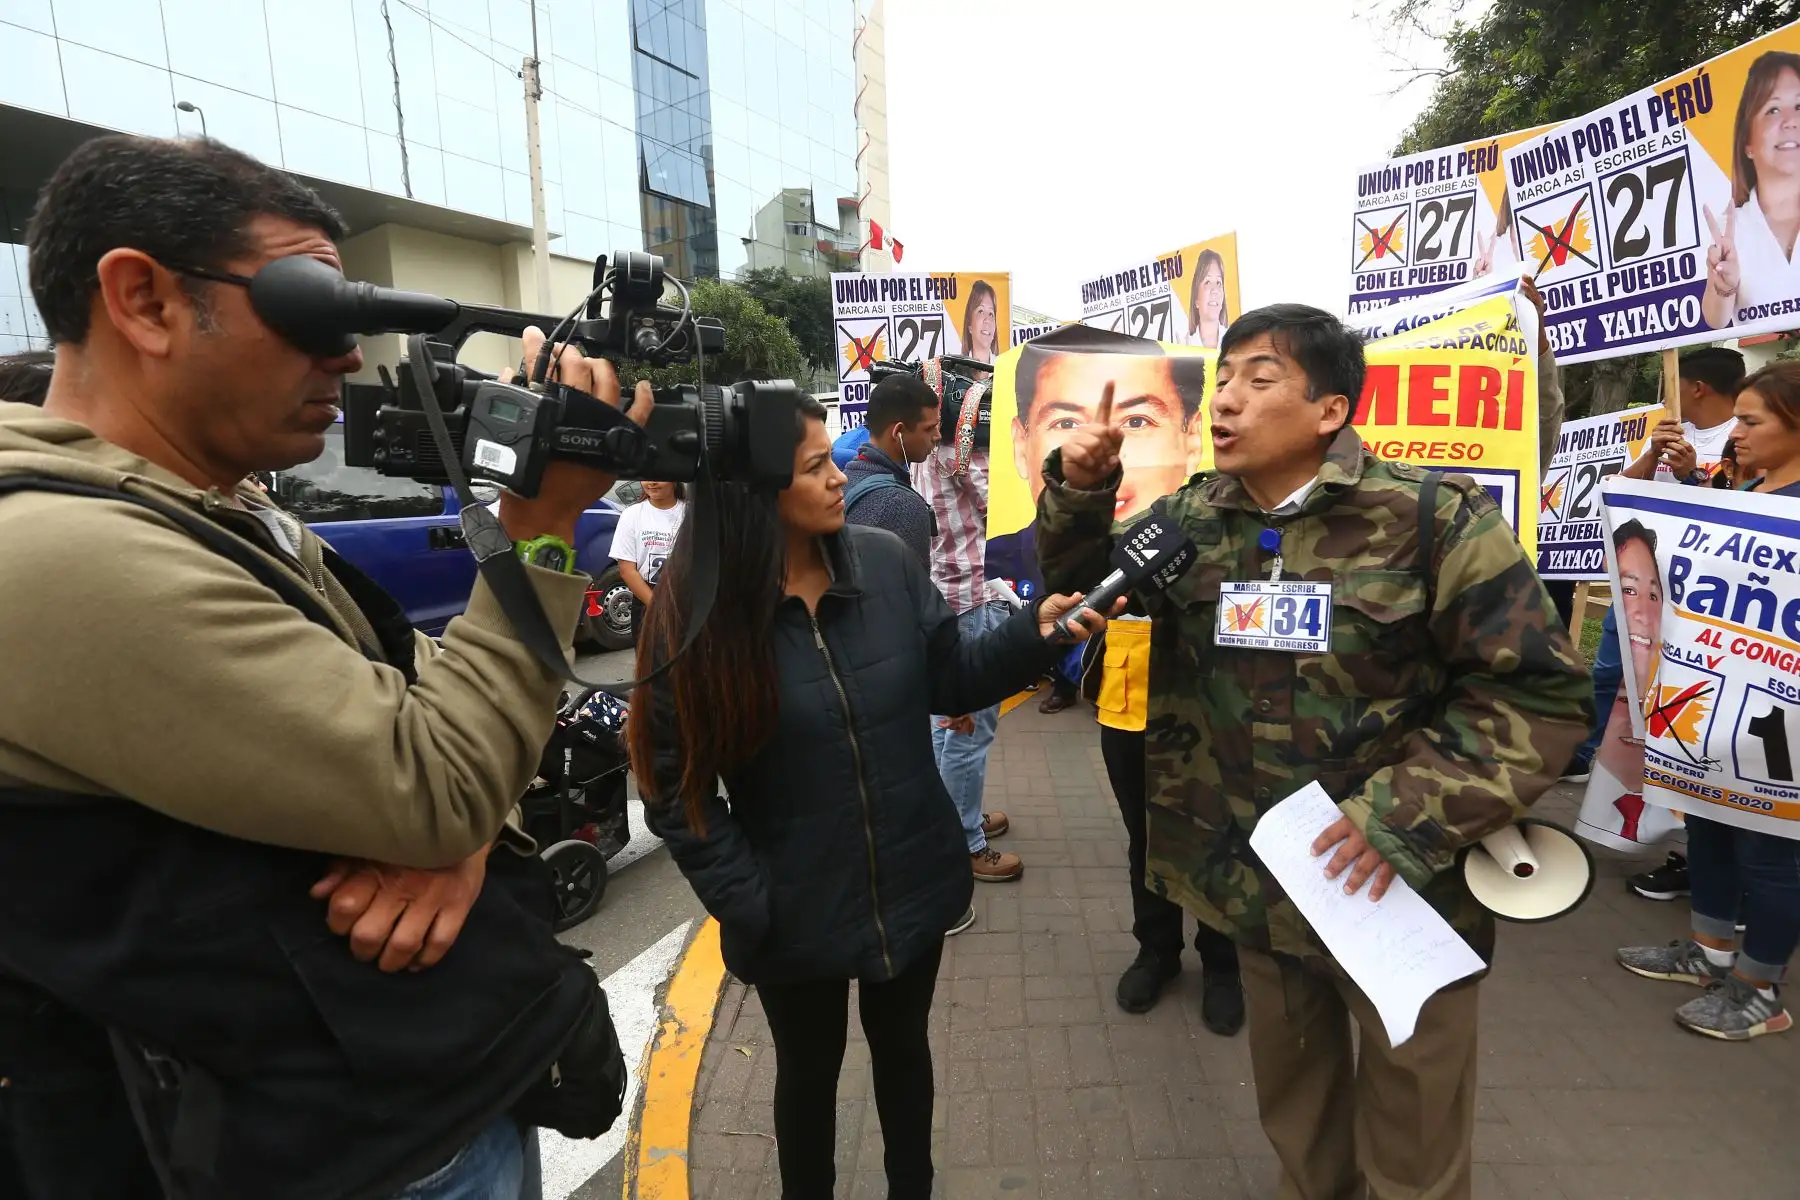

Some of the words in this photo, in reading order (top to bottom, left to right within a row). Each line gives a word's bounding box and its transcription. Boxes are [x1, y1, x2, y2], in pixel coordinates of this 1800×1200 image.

[1510, 136, 1572, 188] UNIÓN
[1572, 117, 1618, 163] POR
[1619, 104, 1647, 145] EL
[1647, 67, 1713, 133] PERÚ
[1595, 140, 1658, 174] ESCRIBE
[1661, 124, 1687, 148] ASÍ
[1358, 164, 1402, 197] UNIÓN
[1405, 159, 1434, 189] POR
[1438, 155, 1453, 182] EL
[1457, 140, 1499, 178] PERÚ
[1415, 181, 1458, 198] ESCRIBE
[1516, 178, 1561, 203] MARCA
[1564, 165, 1585, 186] ASÍ
[1358, 194, 1391, 209] MARCA
[1392, 190, 1409, 202] ASÍ
[1606, 156, 1687, 264] 27
[1415, 196, 1474, 262] 27
[835, 275, 878, 304] UNIÓN
[881, 278, 907, 302] POR
[910, 278, 923, 301] EL
[926, 273, 957, 300] PERÚ
[1082, 275, 1115, 304] UNIÓN
[1116, 269, 1139, 295] POR
[1139, 265, 1152, 289] EL
[1153, 251, 1183, 285] PERÚ
[1356, 273, 1386, 292] CON
[1389, 270, 1405, 287] EL
[1408, 262, 1468, 286] PUEBLO
[1539, 283, 1576, 313] CON
[1580, 278, 1603, 304] EL
[1607, 252, 1697, 299] PUEBLO
[892, 304, 928, 313] ESCRIBE
[1126, 289, 1157, 304] ESCRIBE
[838, 306, 870, 315] MARCA
[871, 305, 886, 314] ASÍ
[1083, 304, 1109, 315] MARCA
[1130, 301, 1170, 341] 27
[1599, 295, 1701, 343] YATACO
[897, 318, 942, 363] 27
[559, 434, 602, 447] SONY
[1570, 428, 1597, 452] POR
[1596, 424, 1610, 448] EL
[1611, 413, 1648, 445] PERÚ
[1576, 449, 1611, 461] ESCRIBE
[1544, 526, 1557, 542] EL
[1123, 544, 1145, 568] Latina
[1548, 548, 1604, 570] YATACO
[1678, 524, 1711, 554] Dr.
[1714, 532, 1800, 574] Alex
[1233, 583, 1261, 592] MARCA
[1282, 584, 1317, 593] ESCRIBE
[1274, 597, 1322, 637] 34
[1236, 637, 1247, 645] POR
[1248, 638, 1254, 646] EL
[1274, 640, 1319, 650] CONGRESO
[1695, 628, 1723, 650] AL
[1686, 650, 1703, 666] LA
[1768, 677, 1800, 700] ESC
[1748, 705, 1794, 782] 1
[1644, 753, 1661, 765] POR
[1662, 760, 1674, 770] EL
[1676, 765, 1705, 780] PERÚ
[1643, 768, 1723, 800] ECCIONES
[1728, 793, 1774, 811] 2020
[1754, 786, 1799, 800] UNIÓN
